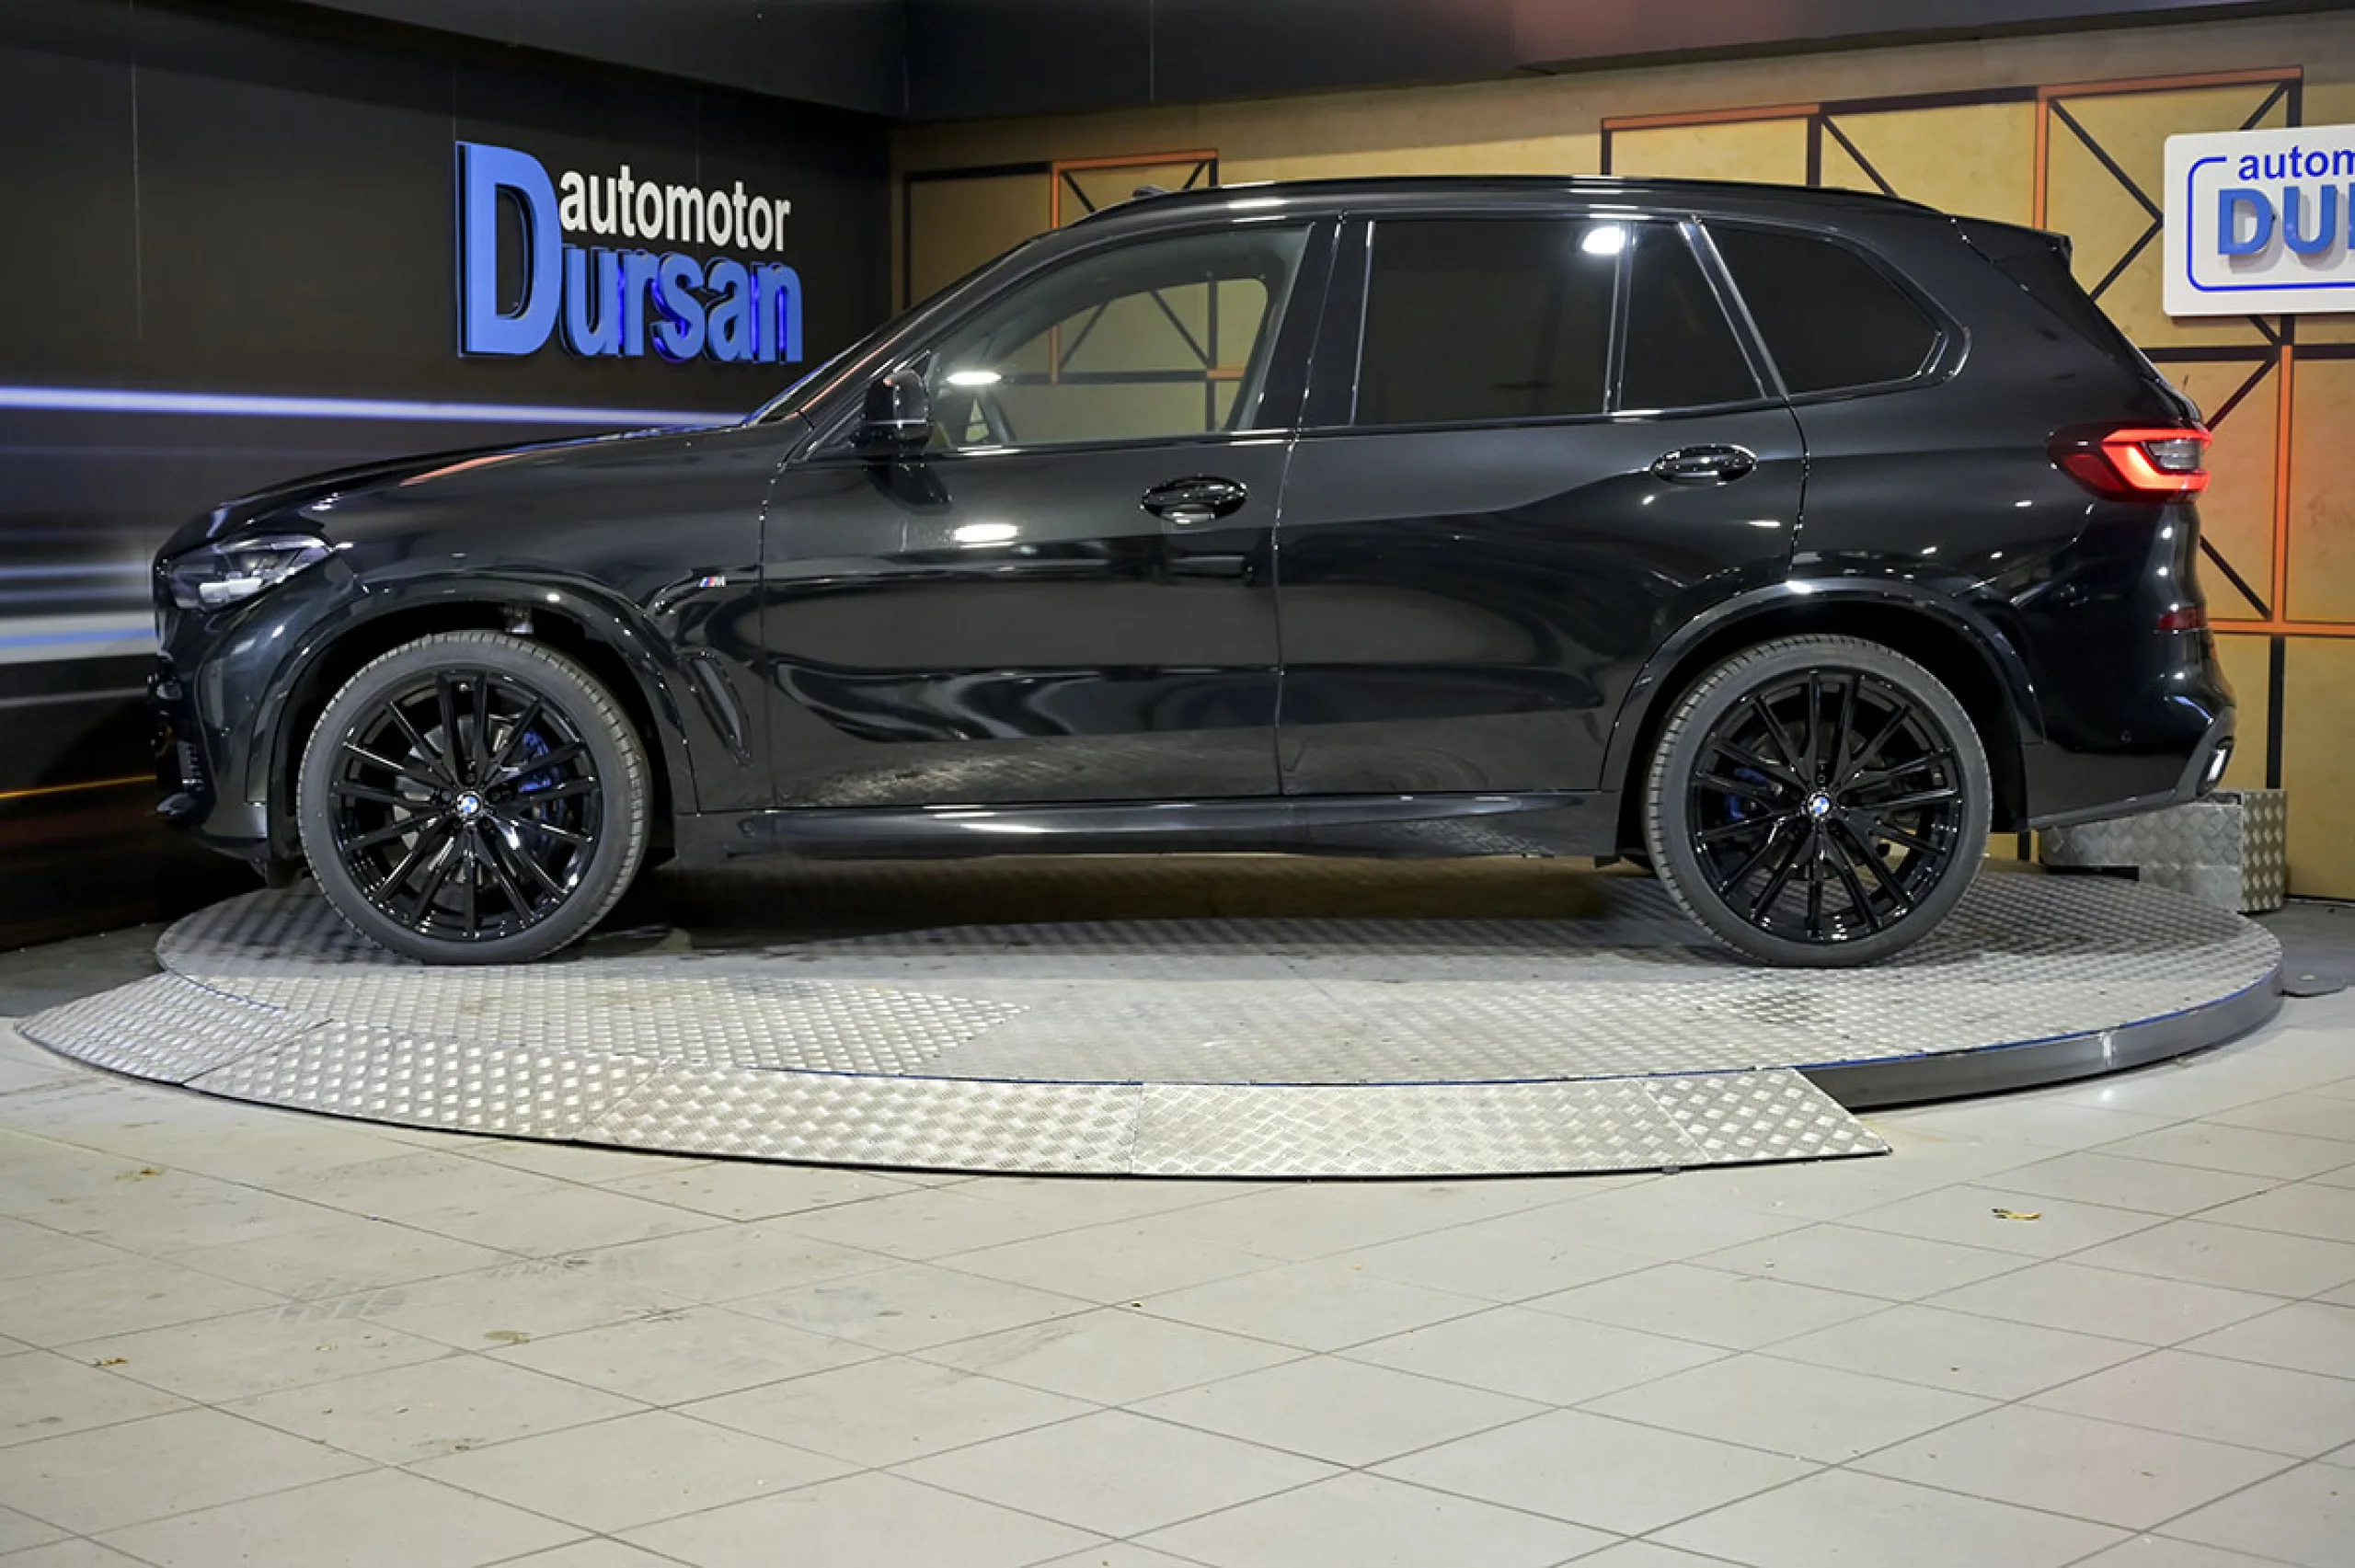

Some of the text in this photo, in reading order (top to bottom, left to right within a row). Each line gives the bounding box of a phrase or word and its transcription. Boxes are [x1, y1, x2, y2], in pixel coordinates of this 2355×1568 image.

[558, 165, 791, 252] automotor
[2218, 183, 2355, 256] DU
[455, 141, 804, 364] Dursan
